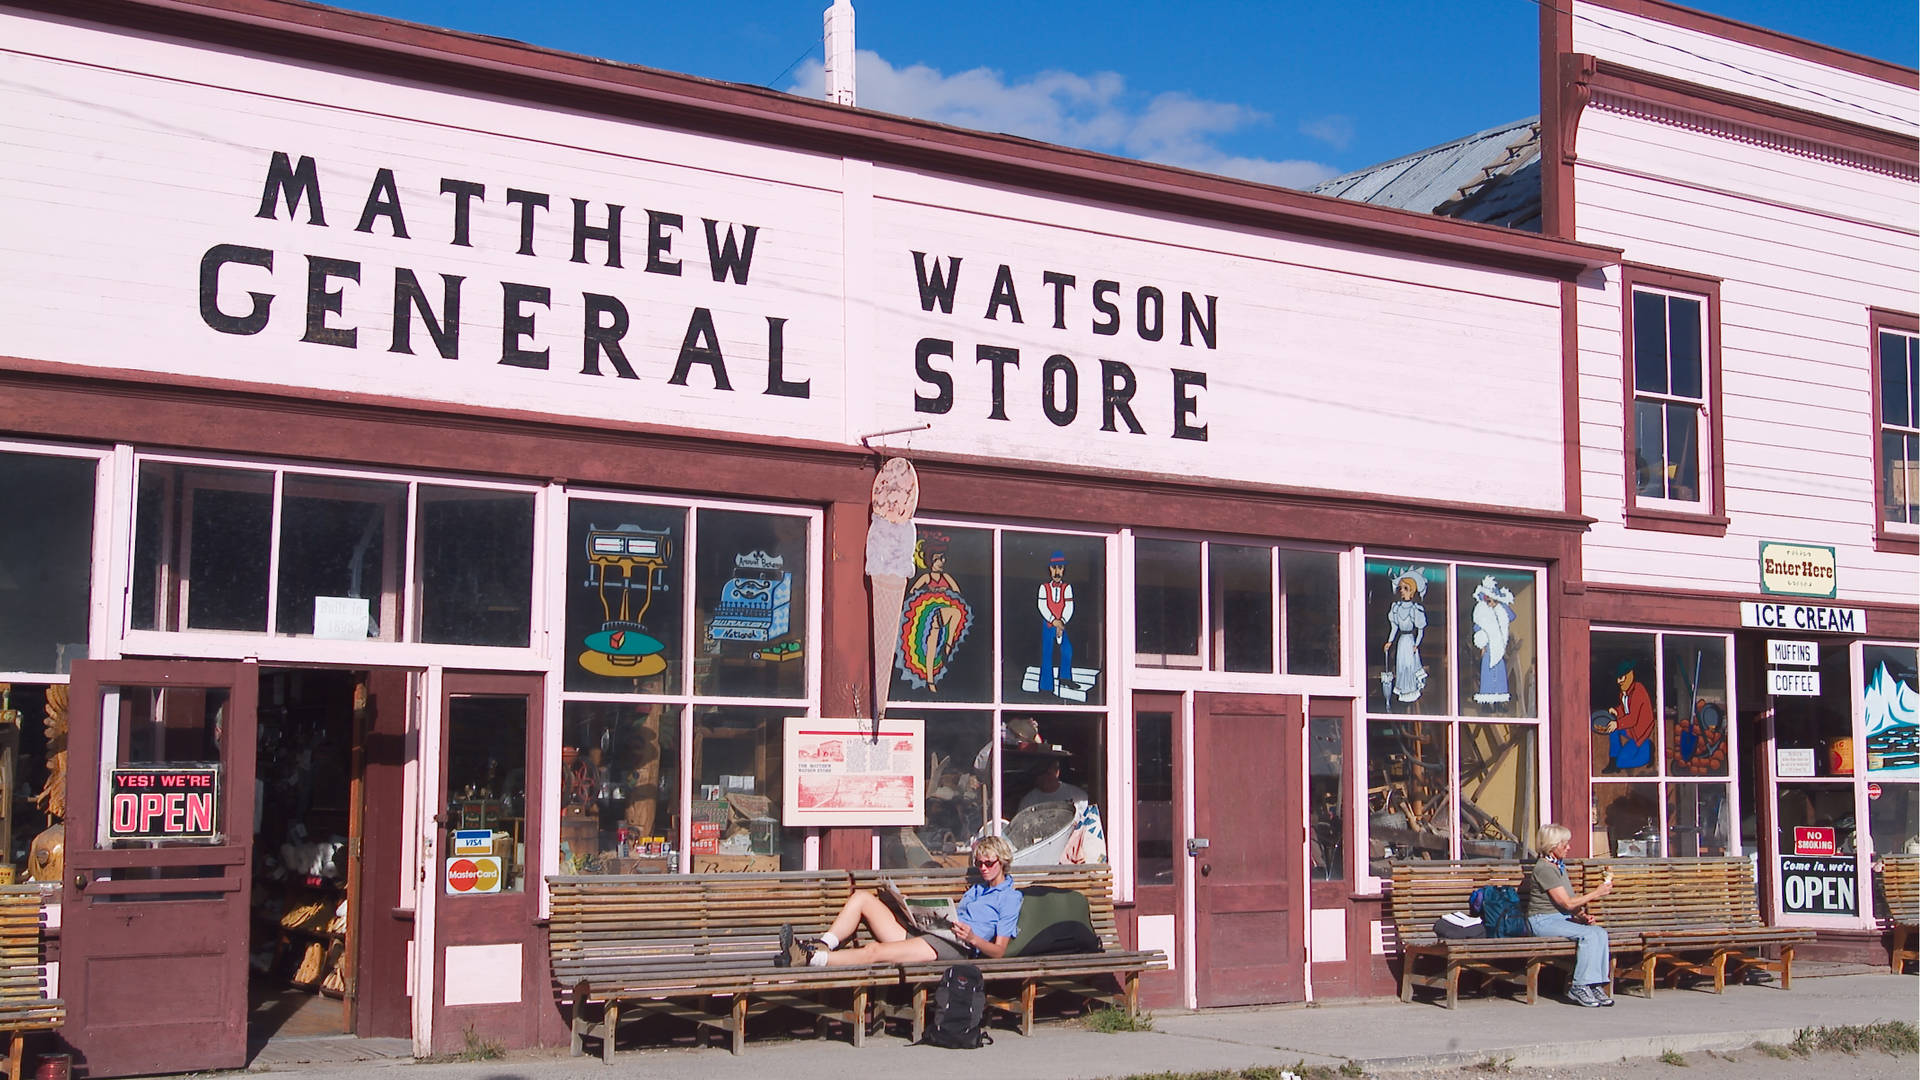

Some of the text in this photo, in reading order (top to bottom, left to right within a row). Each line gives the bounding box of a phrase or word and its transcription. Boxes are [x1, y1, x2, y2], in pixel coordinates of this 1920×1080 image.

[254, 151, 1218, 349] MATTHEW WATSON
[200, 243, 1208, 442] GENERAL STORE
[1765, 558, 1833, 579] Enter Here
[1755, 604, 1855, 633] ICE CREAM
[1774, 643, 1811, 662] MUFFINS
[1775, 674, 1814, 692] COFFEE
[116, 774, 211, 787] YES! WE'RE
[112, 792, 213, 833] OPEN
[1797, 840, 1833, 850] SMOKING
[1806, 831, 1823, 840] NO
[448, 870, 497, 879] MasterCard
[1782, 860, 1810, 872] Come
[1828, 862, 1855, 873] we're
[1785, 874, 1855, 911] OPEN
